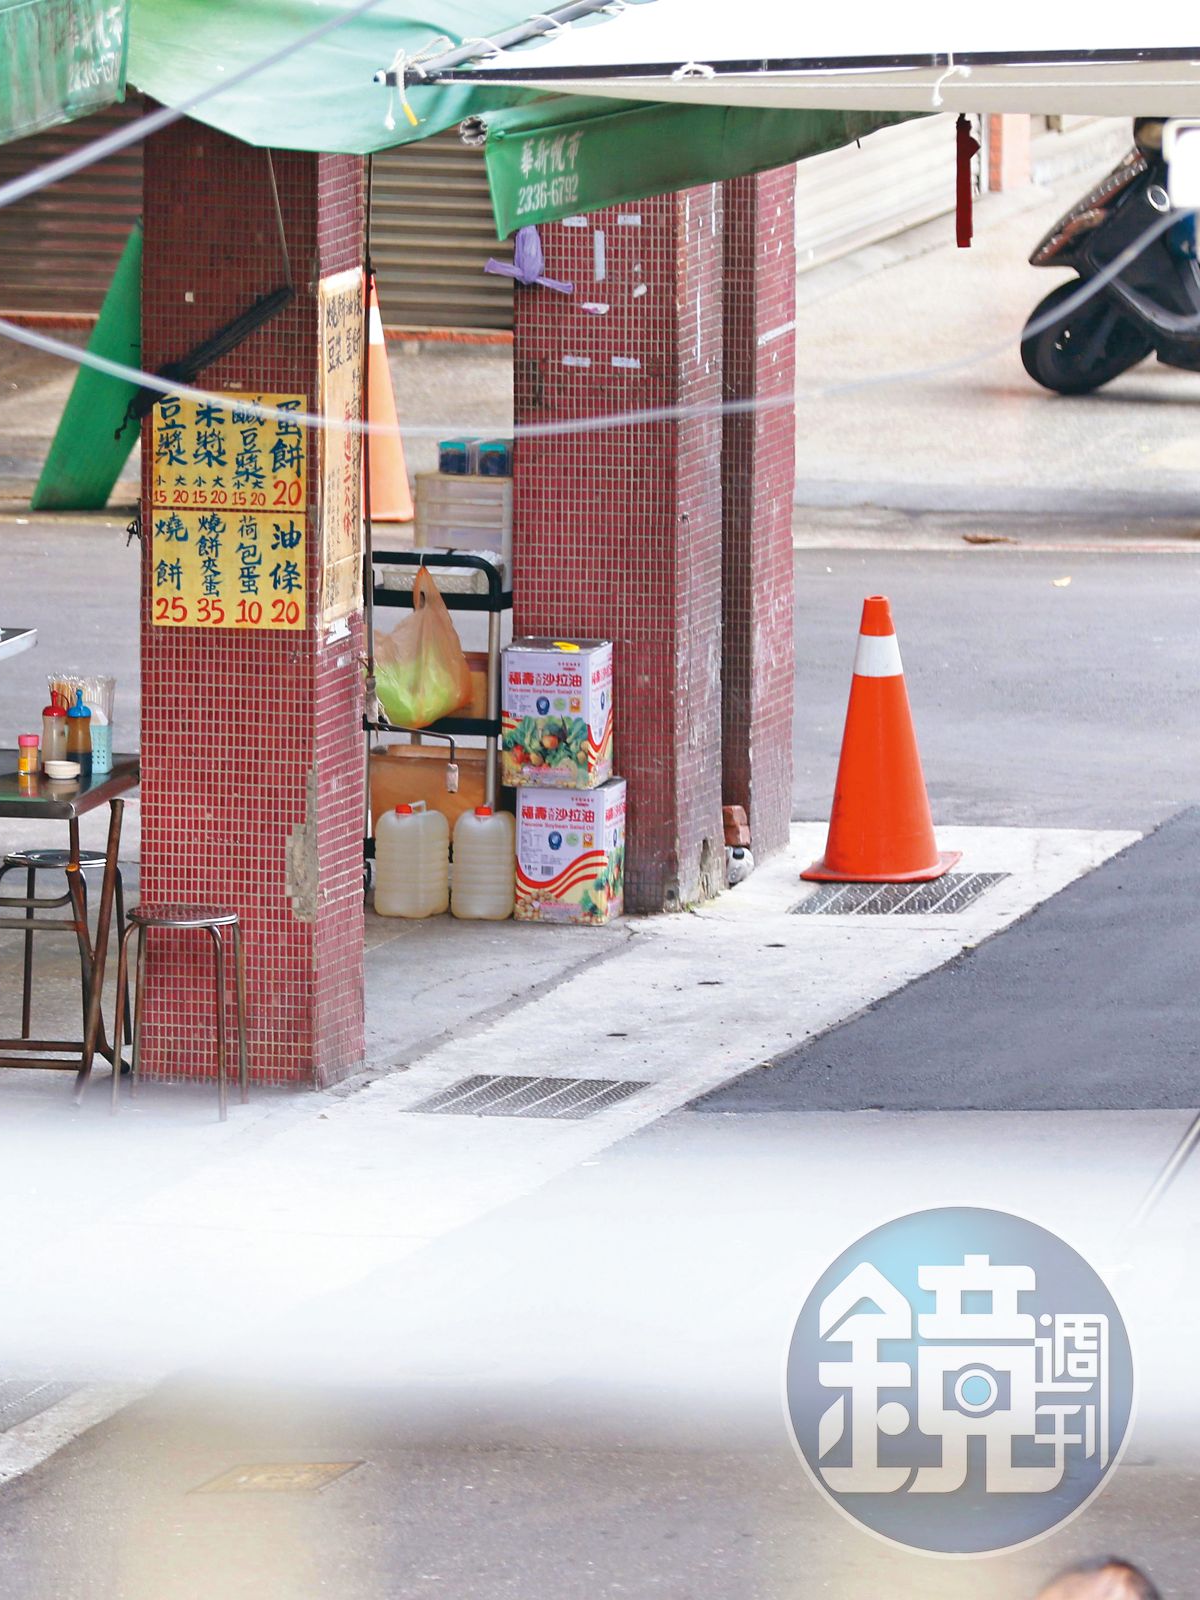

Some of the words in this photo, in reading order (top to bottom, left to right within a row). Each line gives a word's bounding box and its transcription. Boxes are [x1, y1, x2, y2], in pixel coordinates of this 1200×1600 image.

[516, 173, 579, 216] 2336-6792
[155, 397, 188, 466] 豆漿
[193, 400, 227, 468] 米漿
[269, 400, 305, 478] 蛋餅
[154, 490, 167, 504] 15
[172, 489, 189, 504] 20
[192, 490, 207, 504] 15
[210, 490, 228, 505] 20
[232, 491, 246, 506] 15
[250, 492, 266, 506] 20
[272, 479, 303, 506] 20
[156, 475, 166, 486] 小
[175, 475, 187, 487] 大
[193, 476, 207, 487] 小
[212, 475, 226, 488] 大
[233, 479, 246, 489] 小
[251, 478, 265, 489] 大
[154, 512, 189, 591] 燒餅
[195, 512, 226, 597] 燒餅夾蛋
[235, 515, 262, 596] 荷包蛋
[269, 520, 303, 594] 油條
[155, 596, 188, 623] 25
[196, 597, 225, 625] 35
[235, 599, 263, 625] 10
[271, 598, 301, 625] 20
